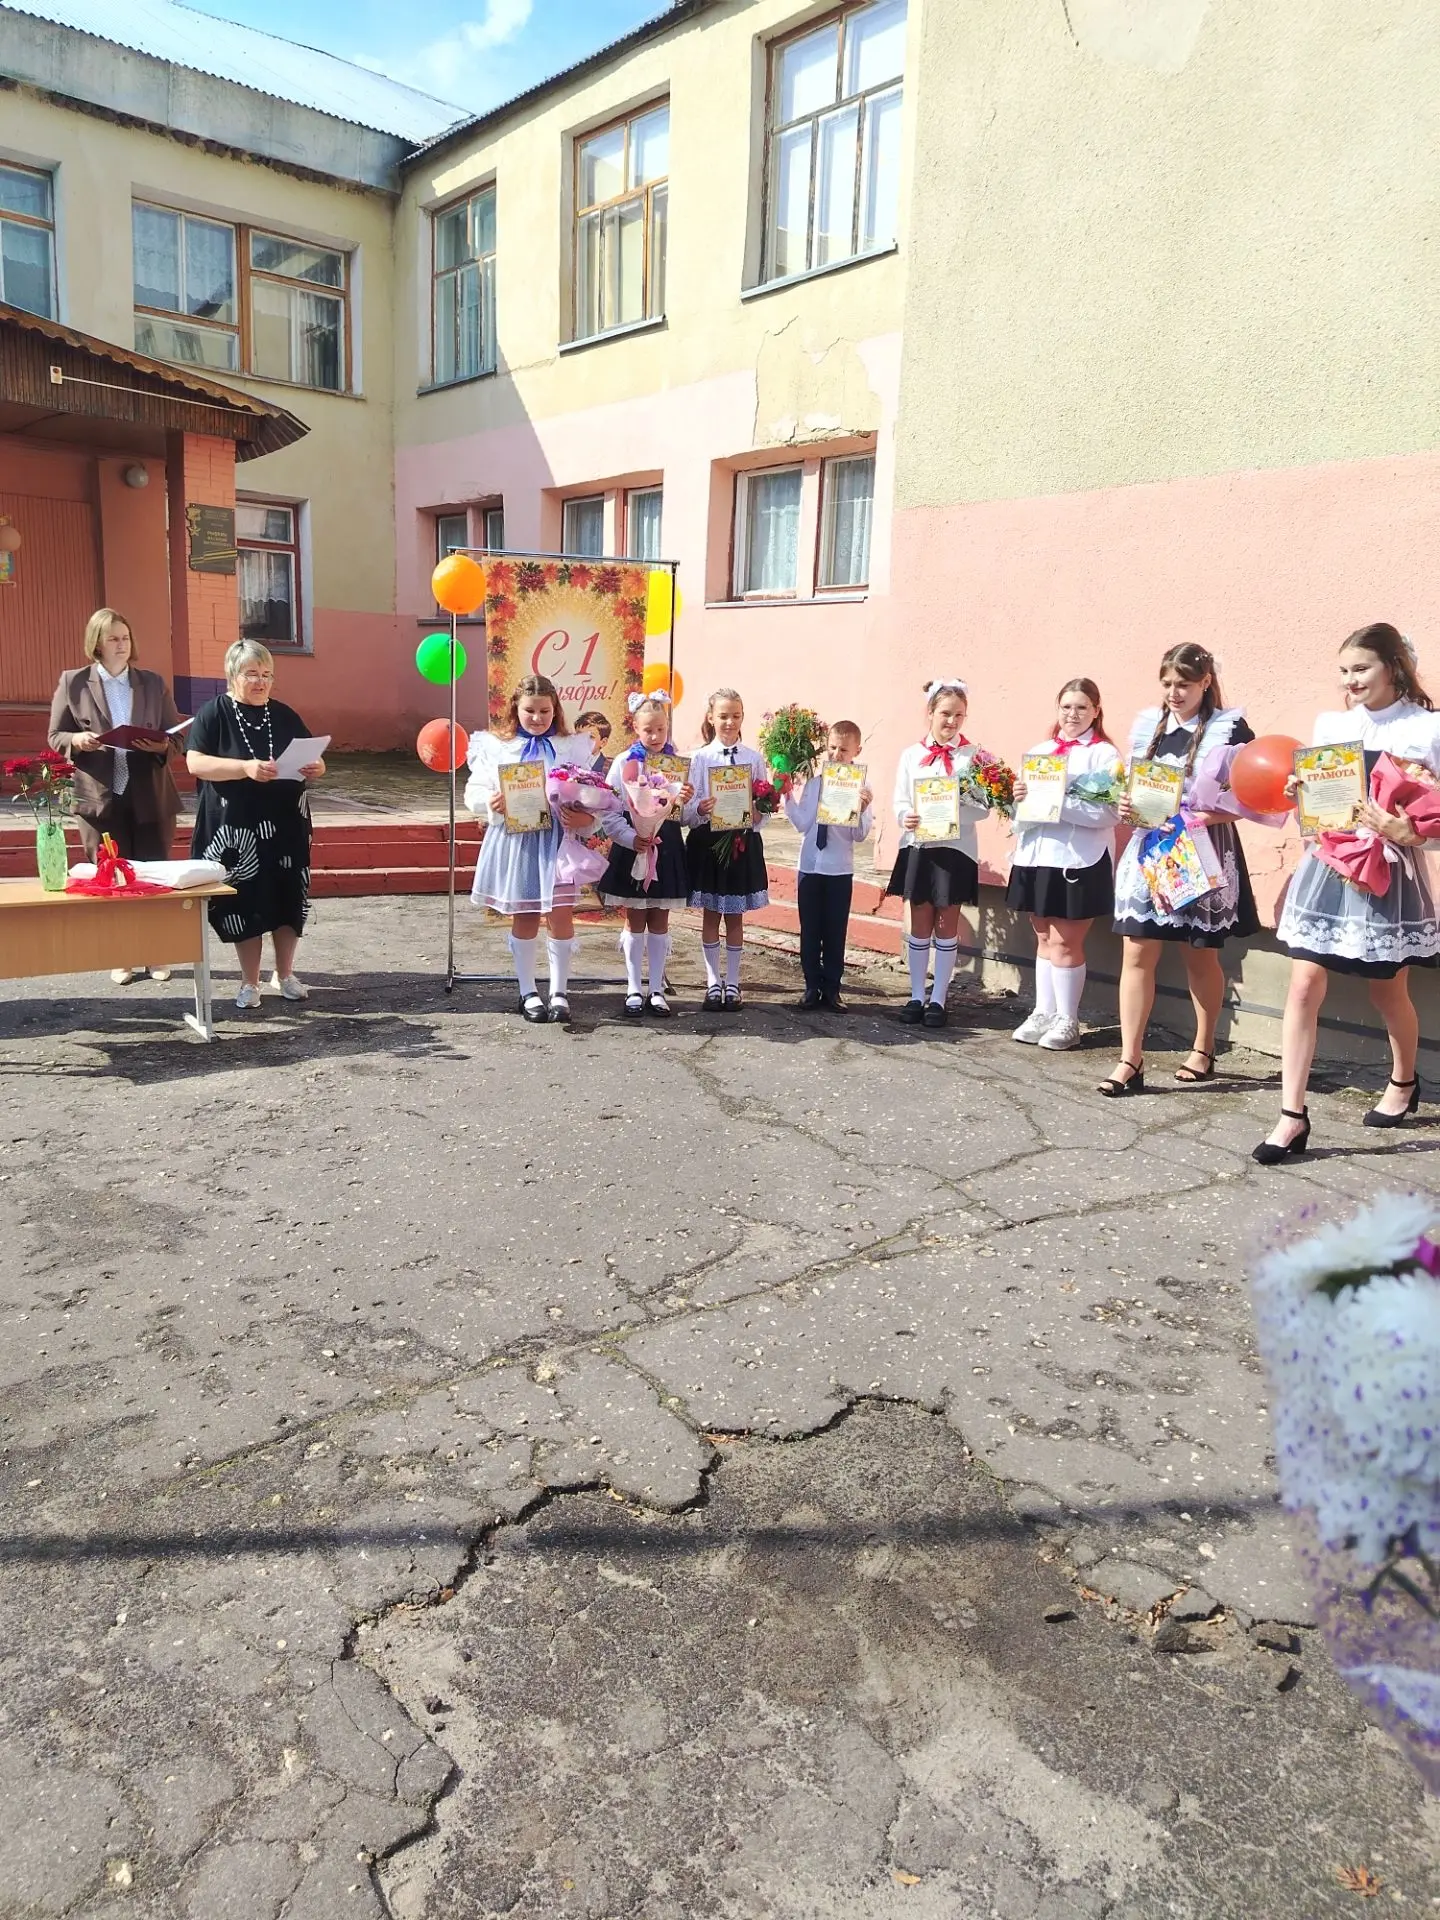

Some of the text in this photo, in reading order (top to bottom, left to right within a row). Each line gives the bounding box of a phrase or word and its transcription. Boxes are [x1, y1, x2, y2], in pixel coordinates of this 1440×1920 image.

[531, 629, 600, 678] С 1
[1306, 768, 1356, 781] ГРАМОТА
[508, 782, 541, 791] ГРАМОТА
[716, 783, 746, 792] ГРАМОТА
[827, 779, 858, 788] ГРАМОТА
[1137, 779, 1176, 793] ГРАМОТА
[920, 795, 953, 804] ГРАМОТА
